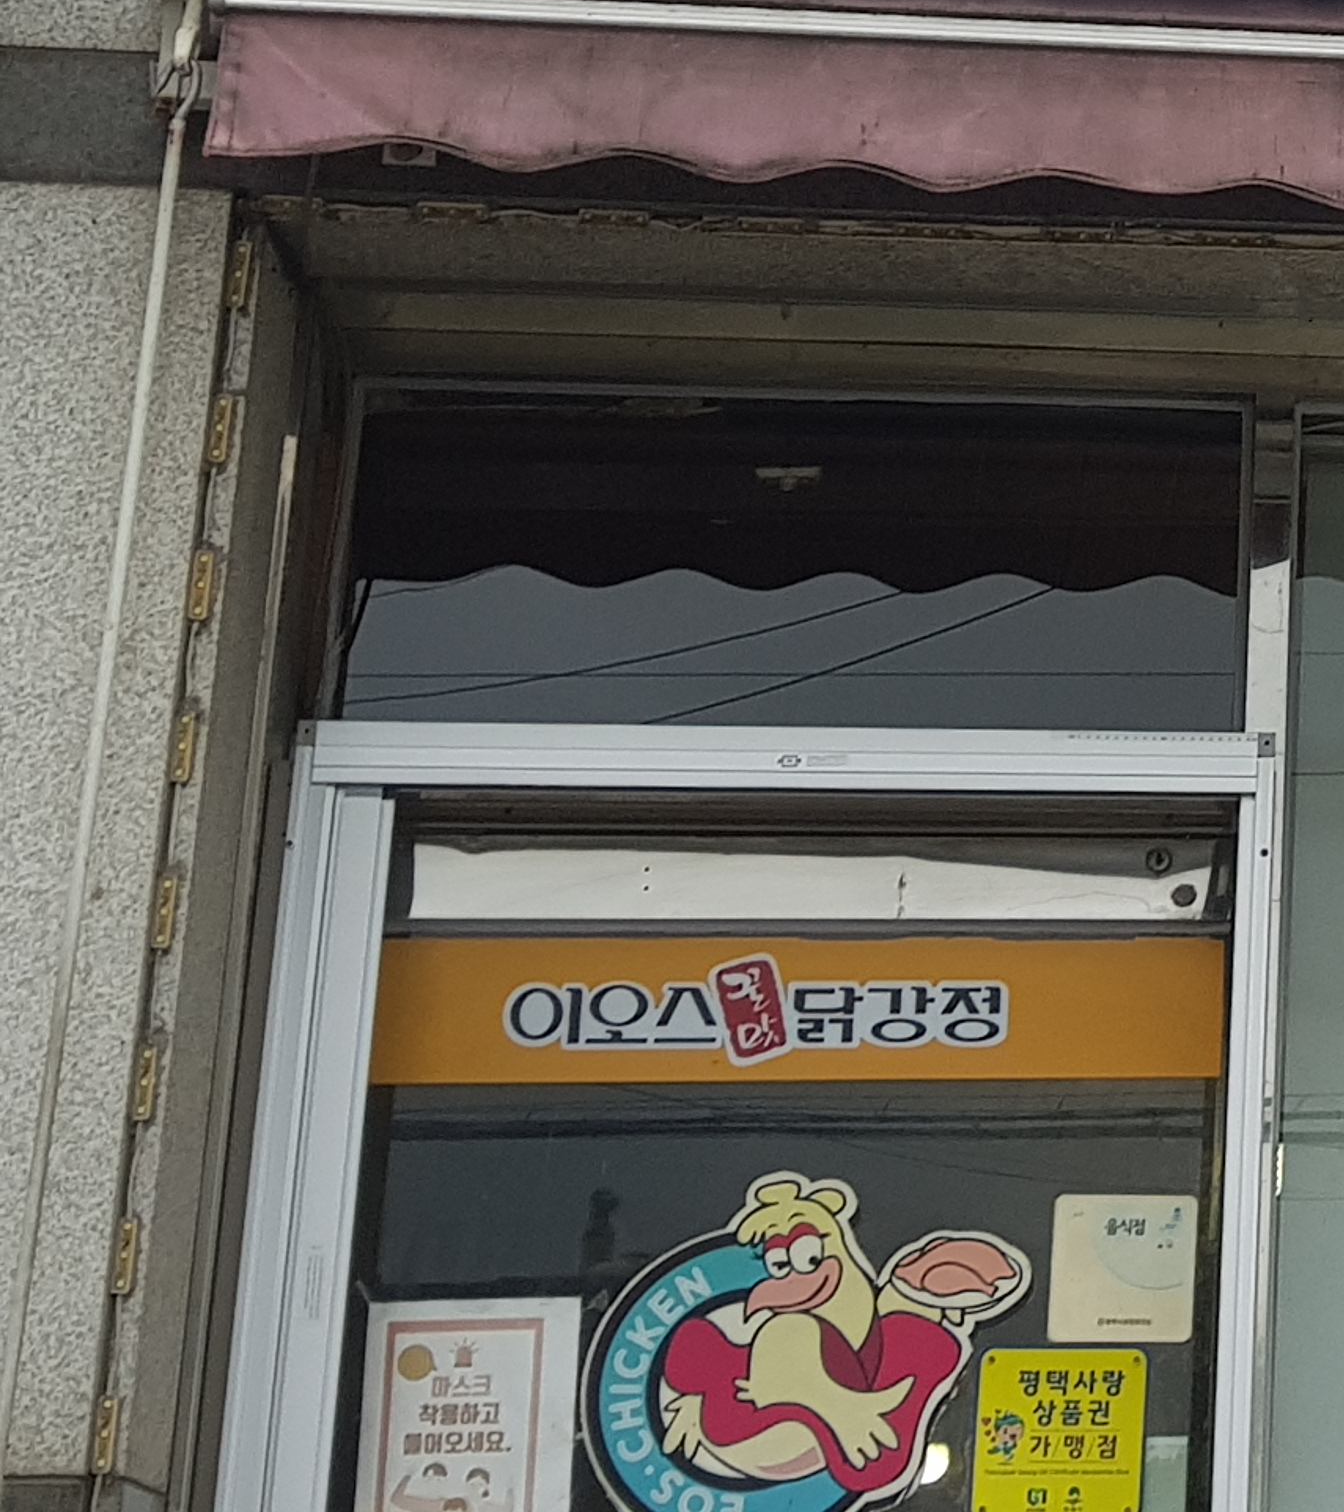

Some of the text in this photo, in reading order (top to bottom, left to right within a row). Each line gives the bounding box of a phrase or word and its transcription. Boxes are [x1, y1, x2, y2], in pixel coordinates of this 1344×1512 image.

[509, 985, 719, 1046] 이오스
[793, 986, 1002, 1044] 닭강정
[431, 1374, 491, 1397] 마스크
[1018, 1370, 1125, 1397] 평택사랑
[418, 1403, 500, 1426] 착용하고
[1033, 1400, 1110, 1427] 상품권
